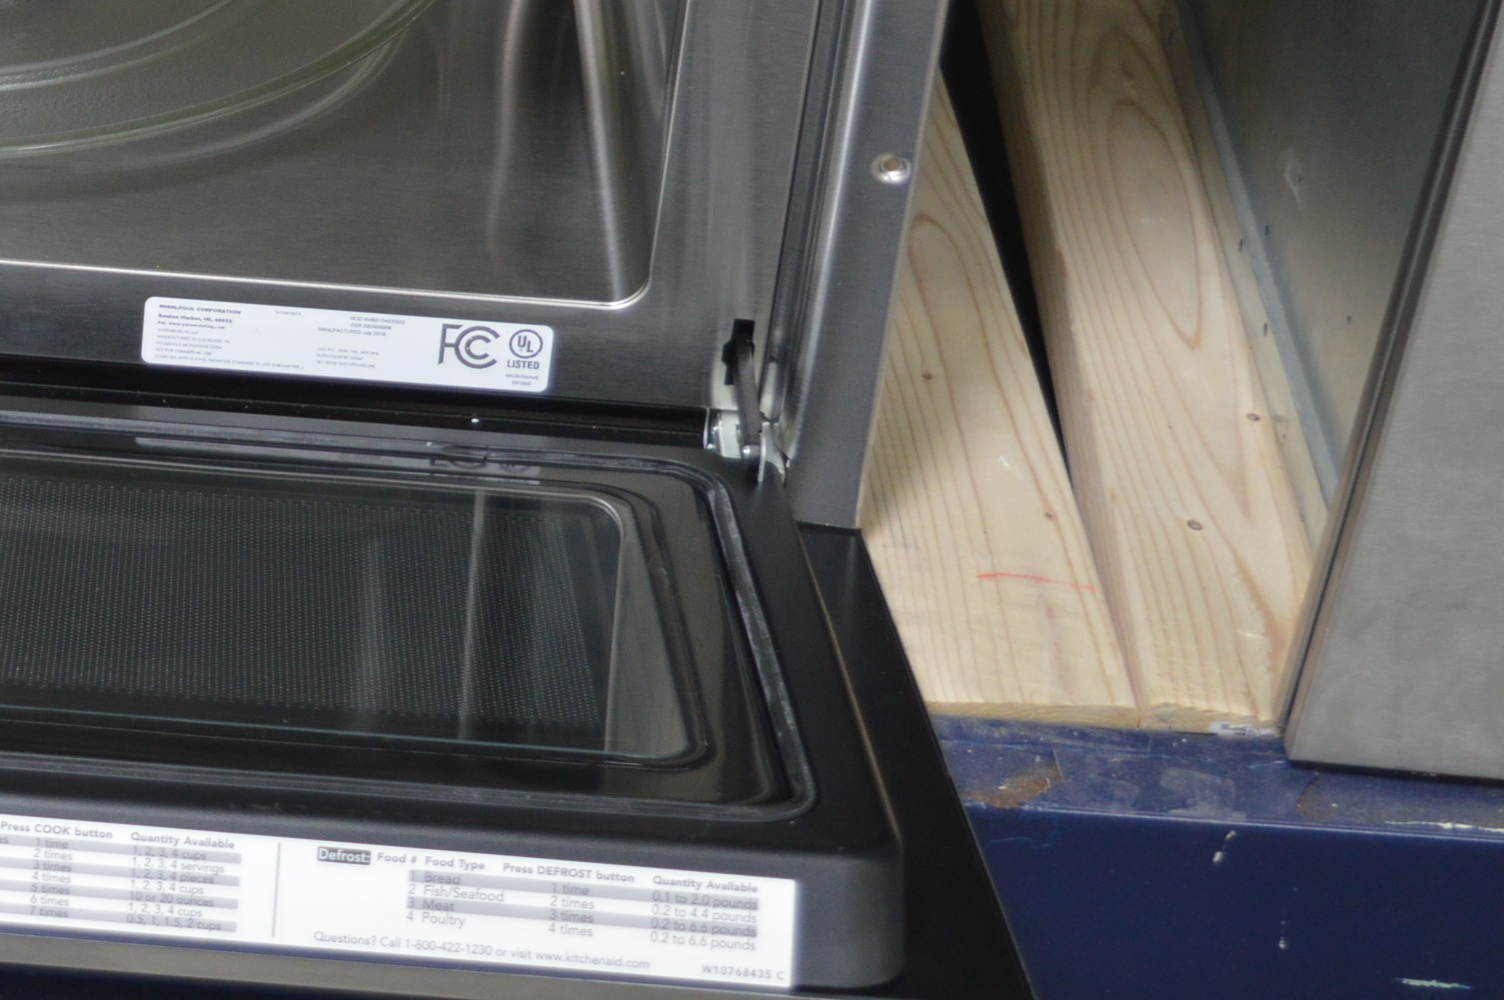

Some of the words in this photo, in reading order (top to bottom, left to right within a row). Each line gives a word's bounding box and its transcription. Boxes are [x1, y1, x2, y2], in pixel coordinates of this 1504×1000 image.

[506, 359, 540, 370] LISTED
[0, 821, 30, 833] Press
[34, 823, 71, 836] COOK
[74, 826, 113, 840] button
[131, 832, 180, 846] Quantity
[183, 836, 235, 850] Available
[318, 848, 370, 865] Defrost:
[377, 852, 406, 864] Food
[425, 856, 454, 868] Food
[458, 859, 485, 871] Type
[503, 862, 533, 875] Press
[536, 865, 592, 880] DEFROST
[596, 869, 635, 883] button
[652, 875, 703, 890] Quantity
[706, 880, 758, 893] Available
[423, 885, 504, 902] Fish/Seafood
[422, 912, 465, 928] Poultry
[313, 930, 377, 946] Questions?
[380, 936, 401, 948] Call
[405, 939, 492, 956] 1-800-422-1230
[495, 948, 507, 957] or
[509, 949, 532, 960] visit
[535, 951, 650, 970] www.kitchenaid.com
[776, 970, 785, 980] C
